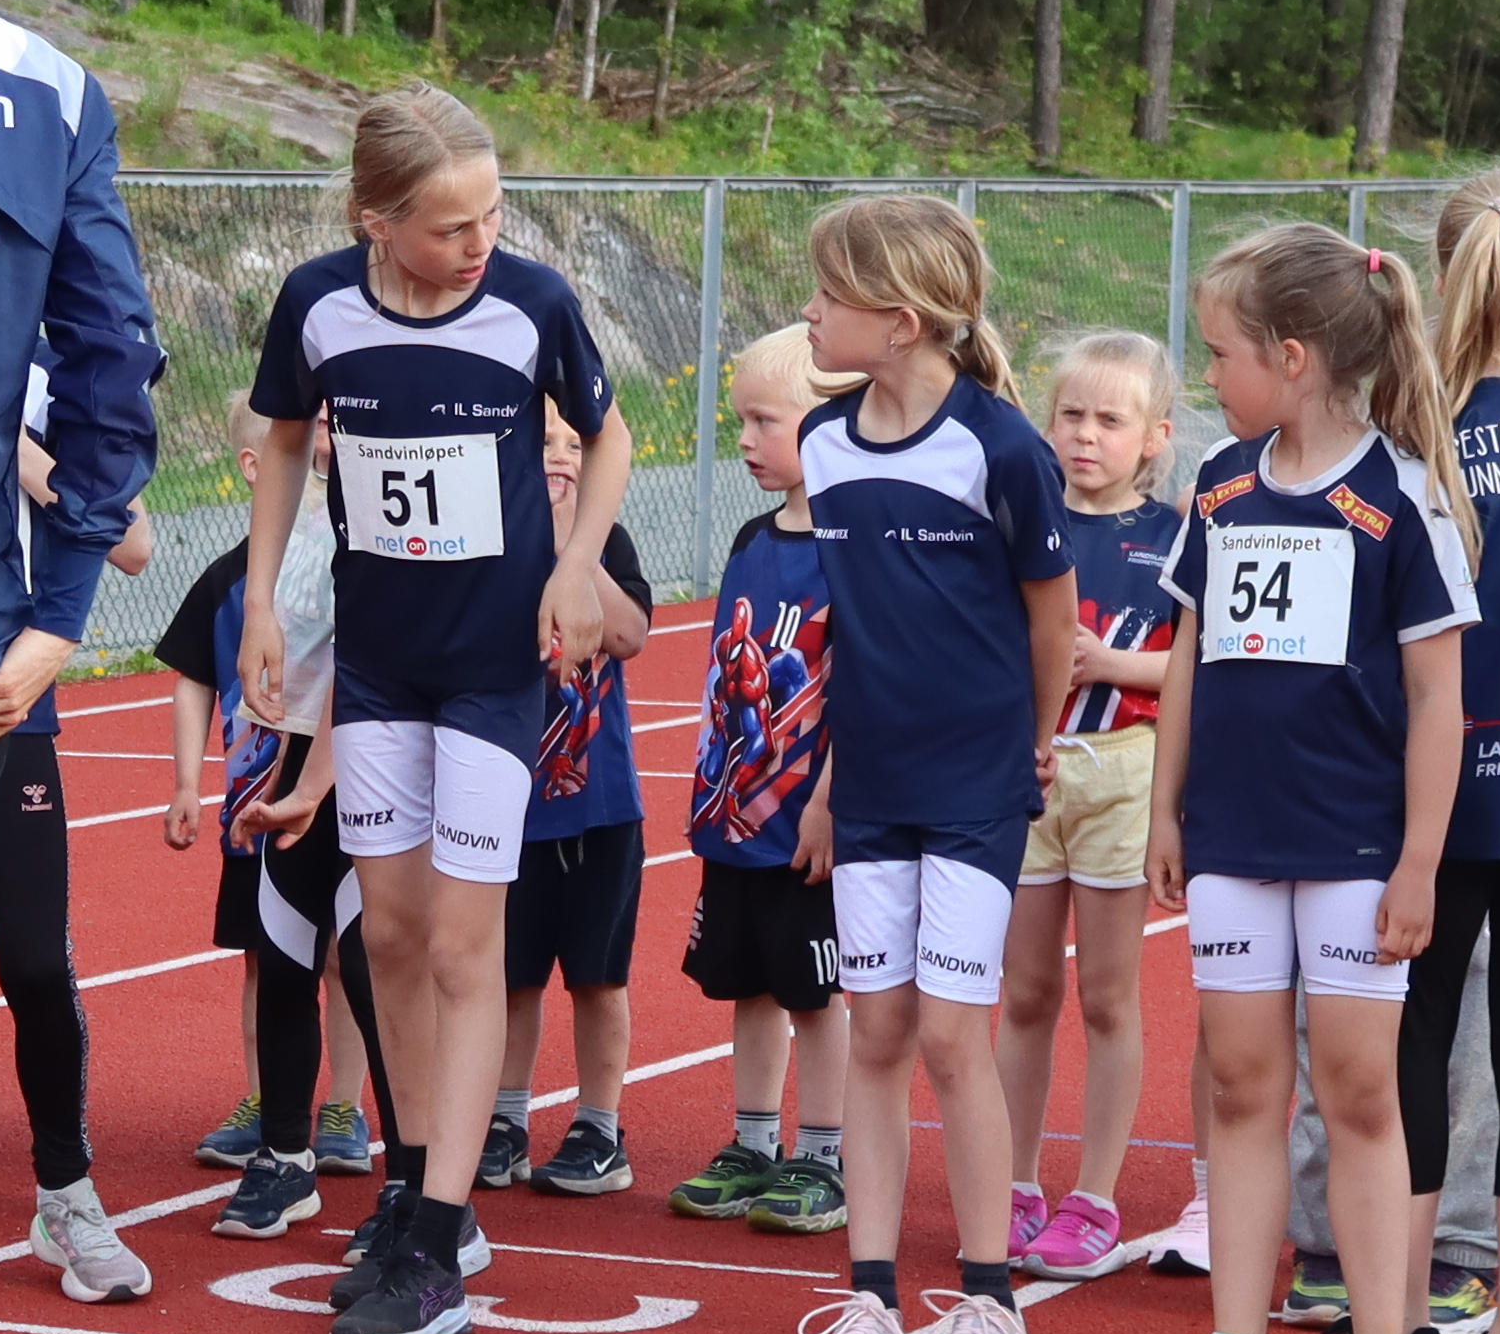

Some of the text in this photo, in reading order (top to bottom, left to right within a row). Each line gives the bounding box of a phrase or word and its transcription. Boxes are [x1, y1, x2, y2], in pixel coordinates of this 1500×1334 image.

[333, 396, 380, 410] TRIMTEX
[454, 402, 519, 418] IL Sandv
[357, 443, 464, 462] Sandvinløpet
[381, 469, 440, 527] 51
[1215, 477, 1252, 501] EXTRA
[901, 527, 974, 542] IL Sandvin
[1222, 532, 1322, 554] Sandvinløpet
[1228, 561, 1294, 624] 54
[769, 601, 802, 651] 10
[1190, 940, 1252, 958] RIMTEX
[1320, 944, 1402, 966] SAND
[809, 937, 840, 985] 10
[919, 946, 988, 978] SANDVIN
